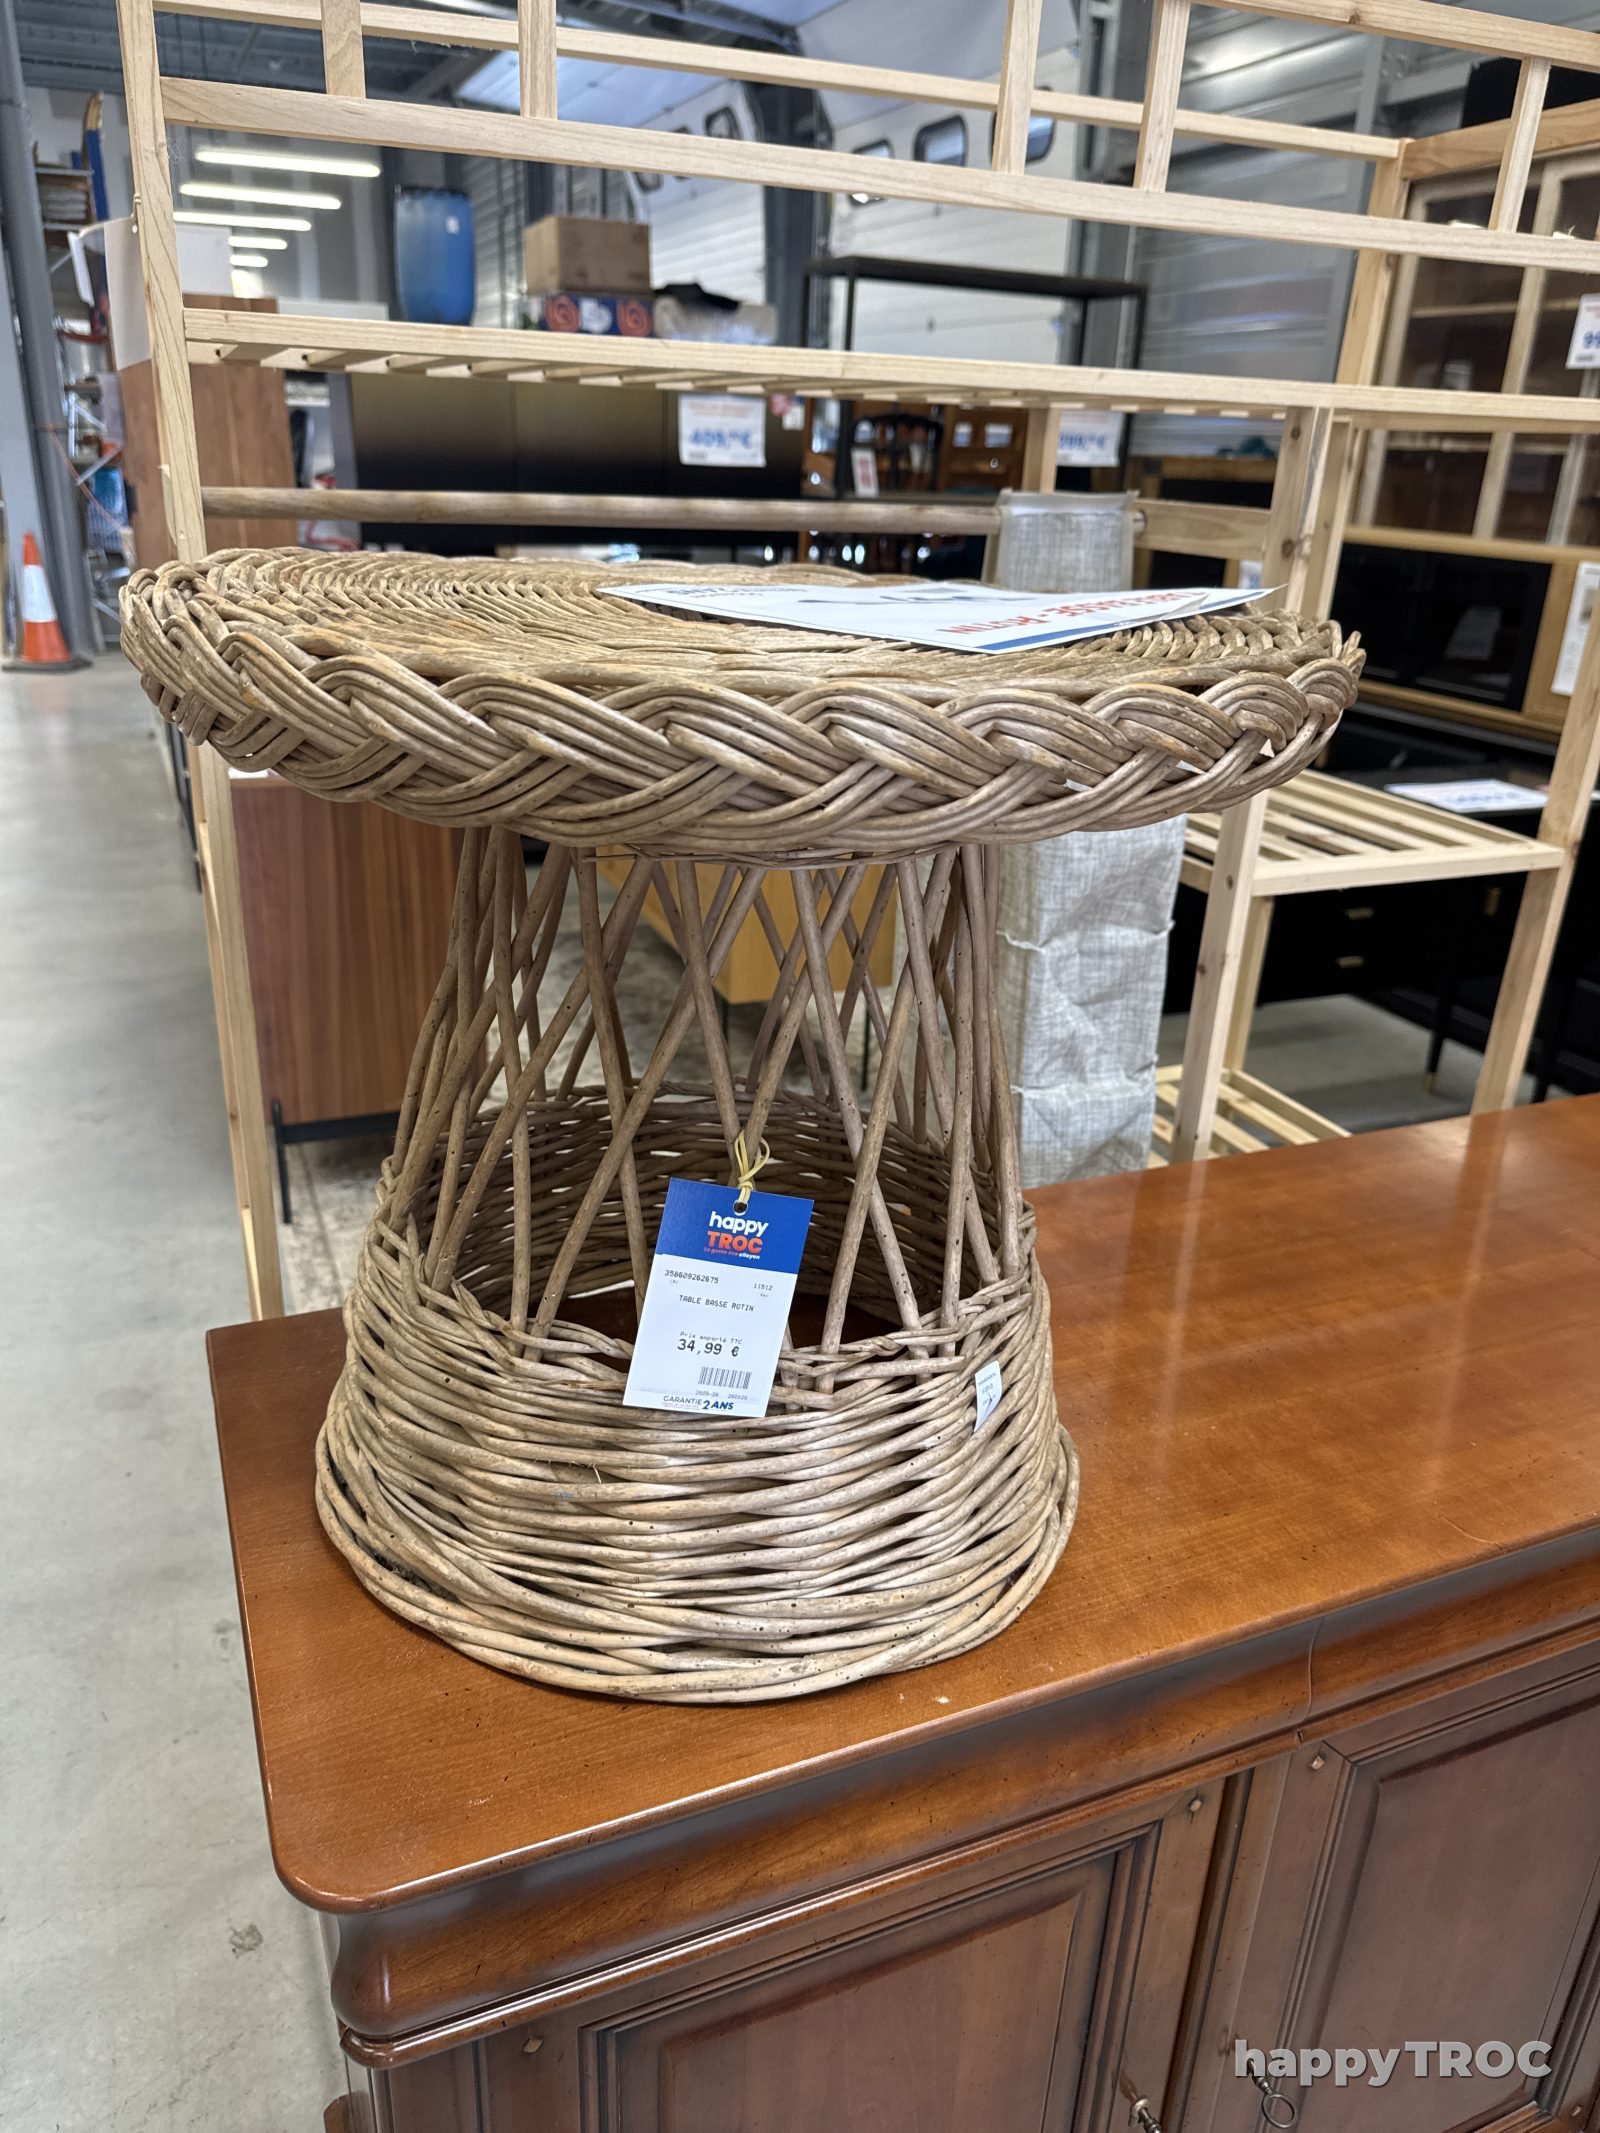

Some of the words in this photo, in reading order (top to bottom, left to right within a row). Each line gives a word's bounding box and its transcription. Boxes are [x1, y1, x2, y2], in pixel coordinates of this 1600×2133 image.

[709, 1210, 769, 1238] happy
[707, 1230, 763, 1254] TROC
[679, 1294, 702, 1304] TABLE
[705, 1298, 729, 1308] BASSE
[731, 1301, 755, 1312] ROTIN
[677, 1338, 723, 1356] 34,99
[731, 1345, 741, 1358] €
[663, 1395, 702, 1406] GARANTIE
[702, 1400, 711, 1410] 2
[711, 1400, 735, 1410] ANS
